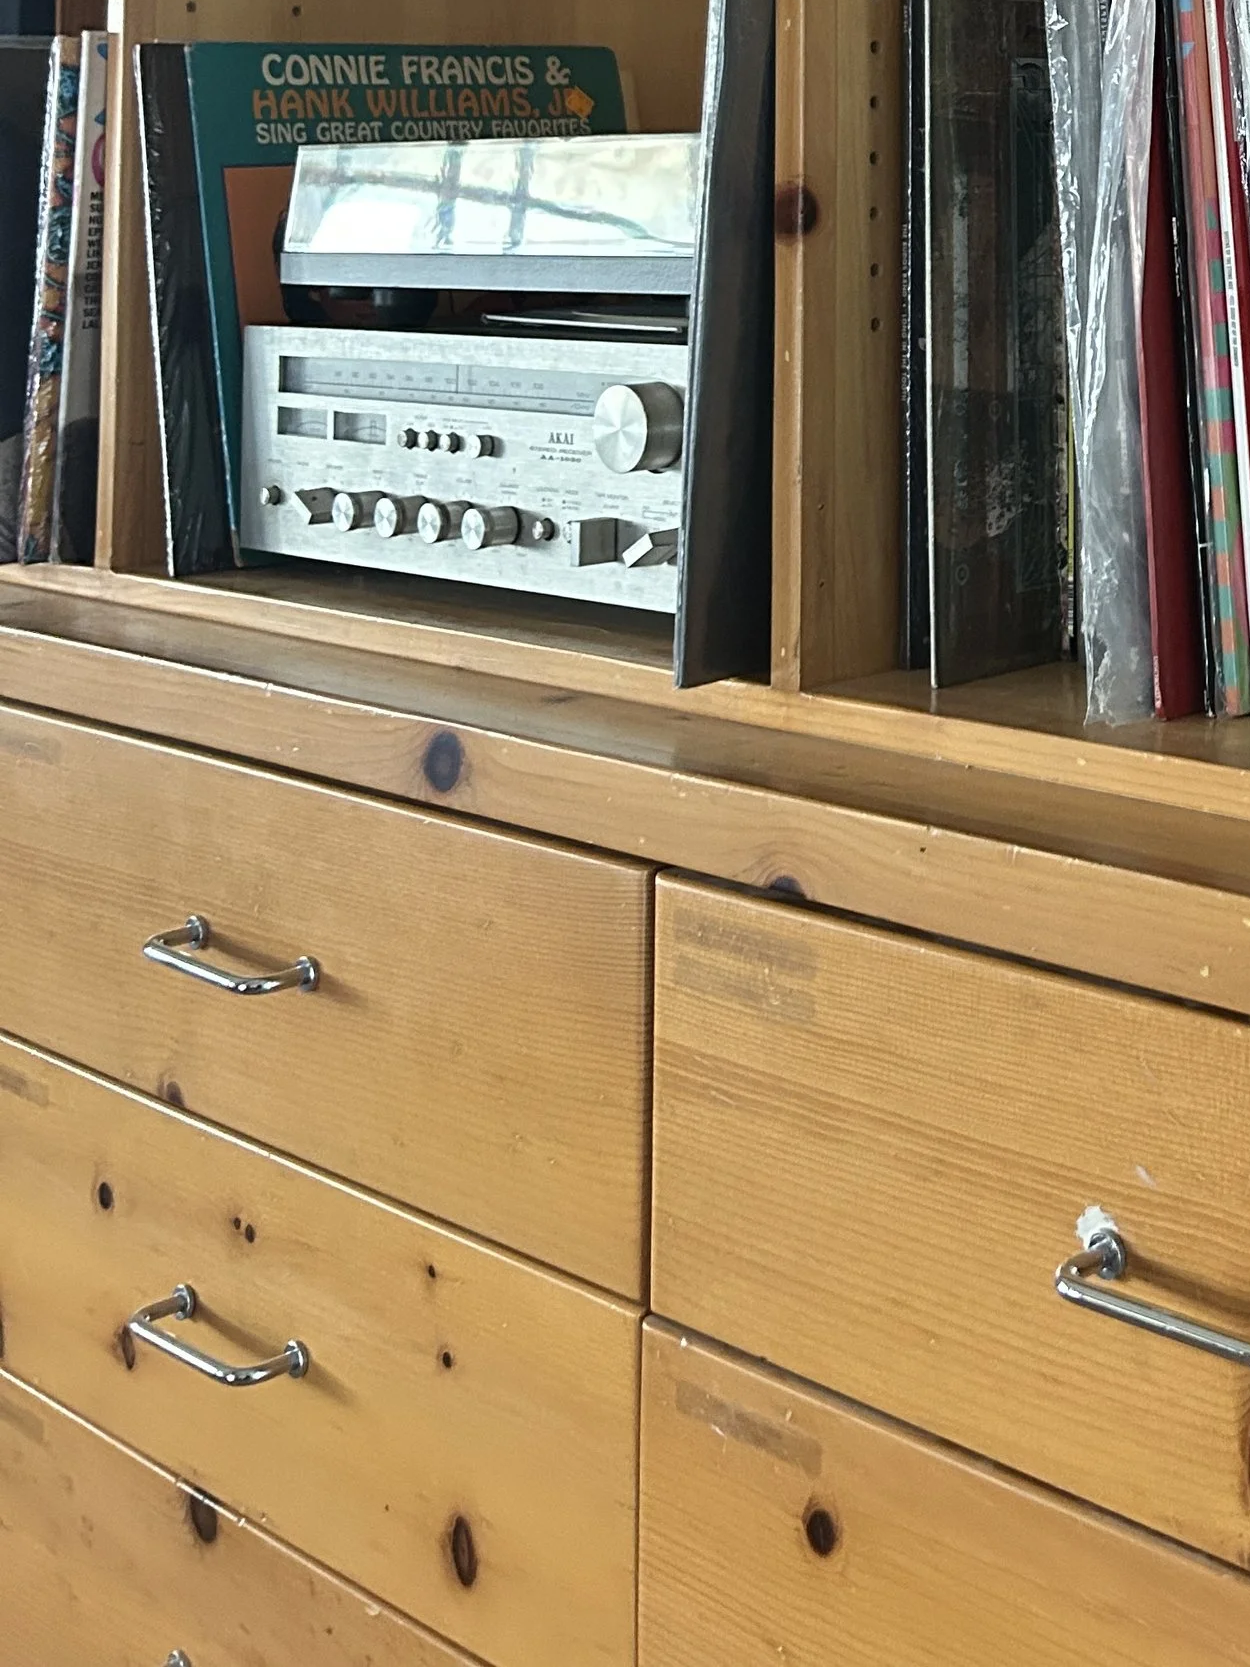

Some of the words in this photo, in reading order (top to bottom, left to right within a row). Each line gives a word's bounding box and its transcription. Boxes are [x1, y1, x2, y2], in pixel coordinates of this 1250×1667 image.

[262, 53, 390, 85] CONNIE
[402, 54, 534, 85] FRANCIS
[545, 55, 571, 85] &
[252, 88, 353, 120] HANK
[366, 87, 541, 119] WILLIAMS,
[255, 122, 307, 145] SING
[316, 120, 384, 143] GREAT
[391, 118, 484, 141] COUNTRY
[491, 117, 592, 137] FAVORITES
[529, 445, 560, 455] STEREO
[562, 447, 593, 457] RECEIVER
[548, 432, 575, 445] AKAI
